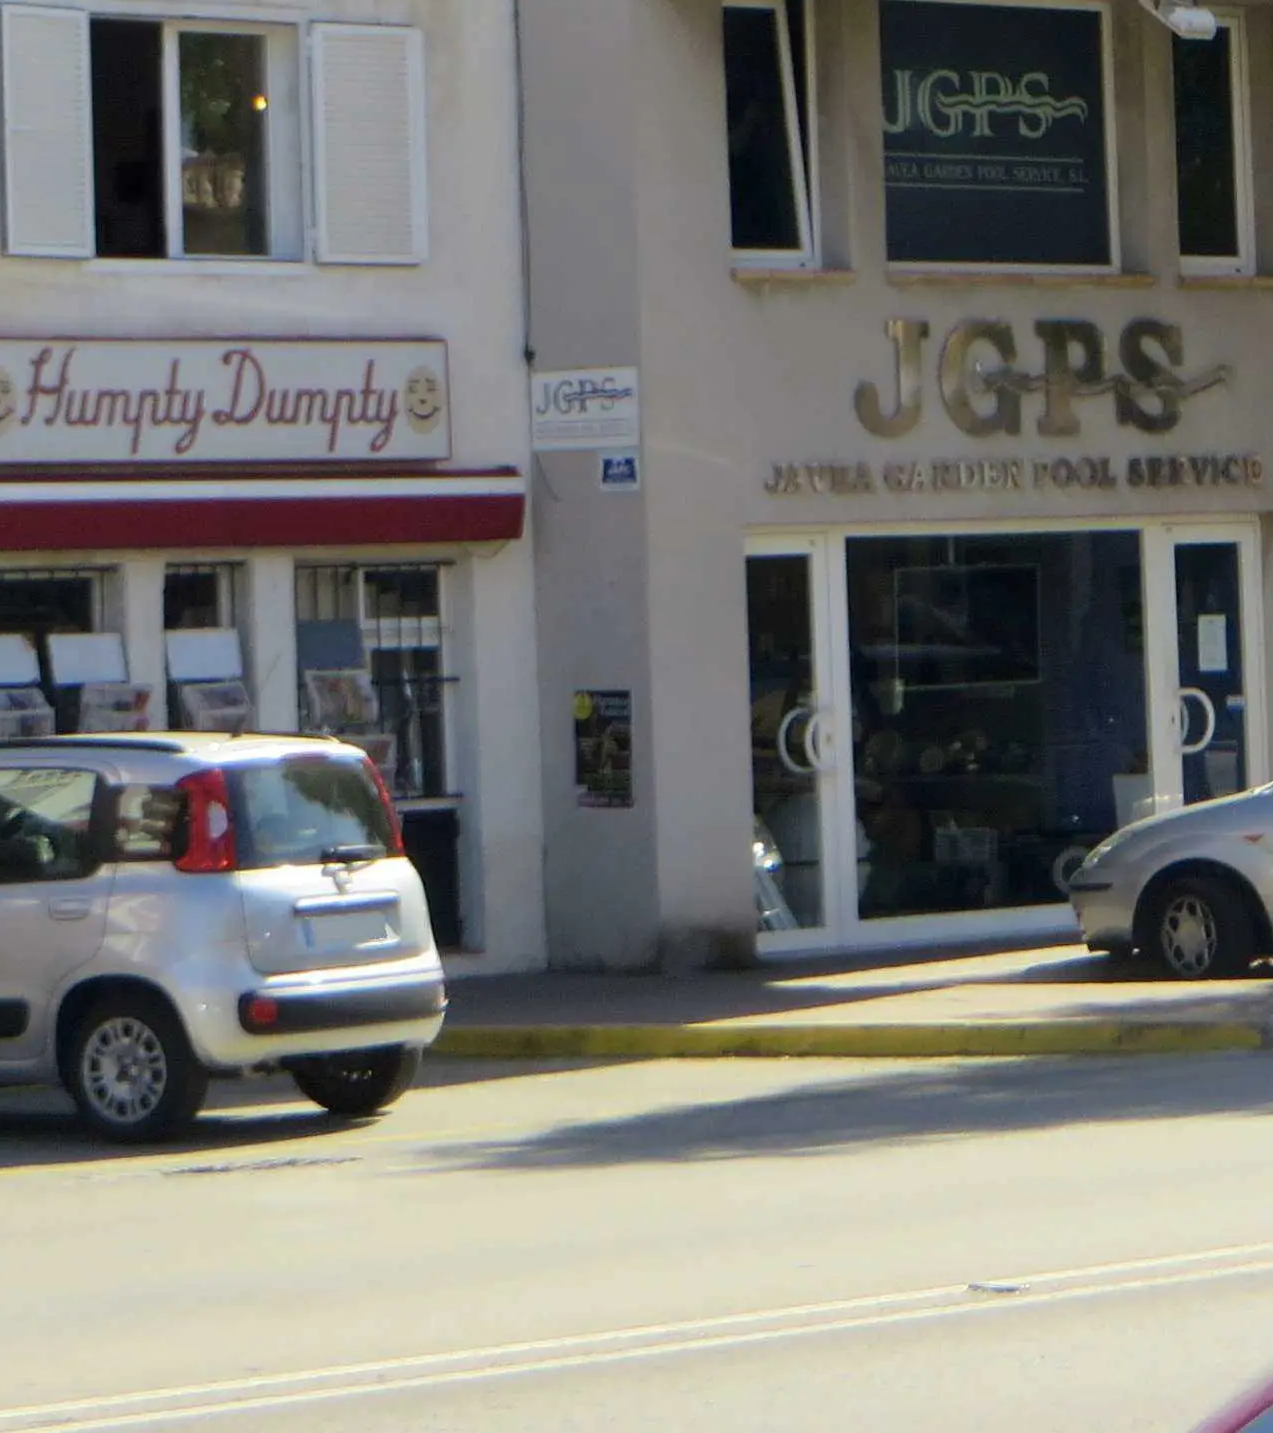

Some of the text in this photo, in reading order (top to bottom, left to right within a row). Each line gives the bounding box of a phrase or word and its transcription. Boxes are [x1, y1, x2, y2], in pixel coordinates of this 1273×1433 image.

[883, 69, 1057, 139] JGPS
[20, 348, 400, 455] Humpty Dumpty
[536, 377, 617, 415] JGPS
[854, 318, 1185, 437] JGPS
[1032, 457, 1118, 490] POOL
